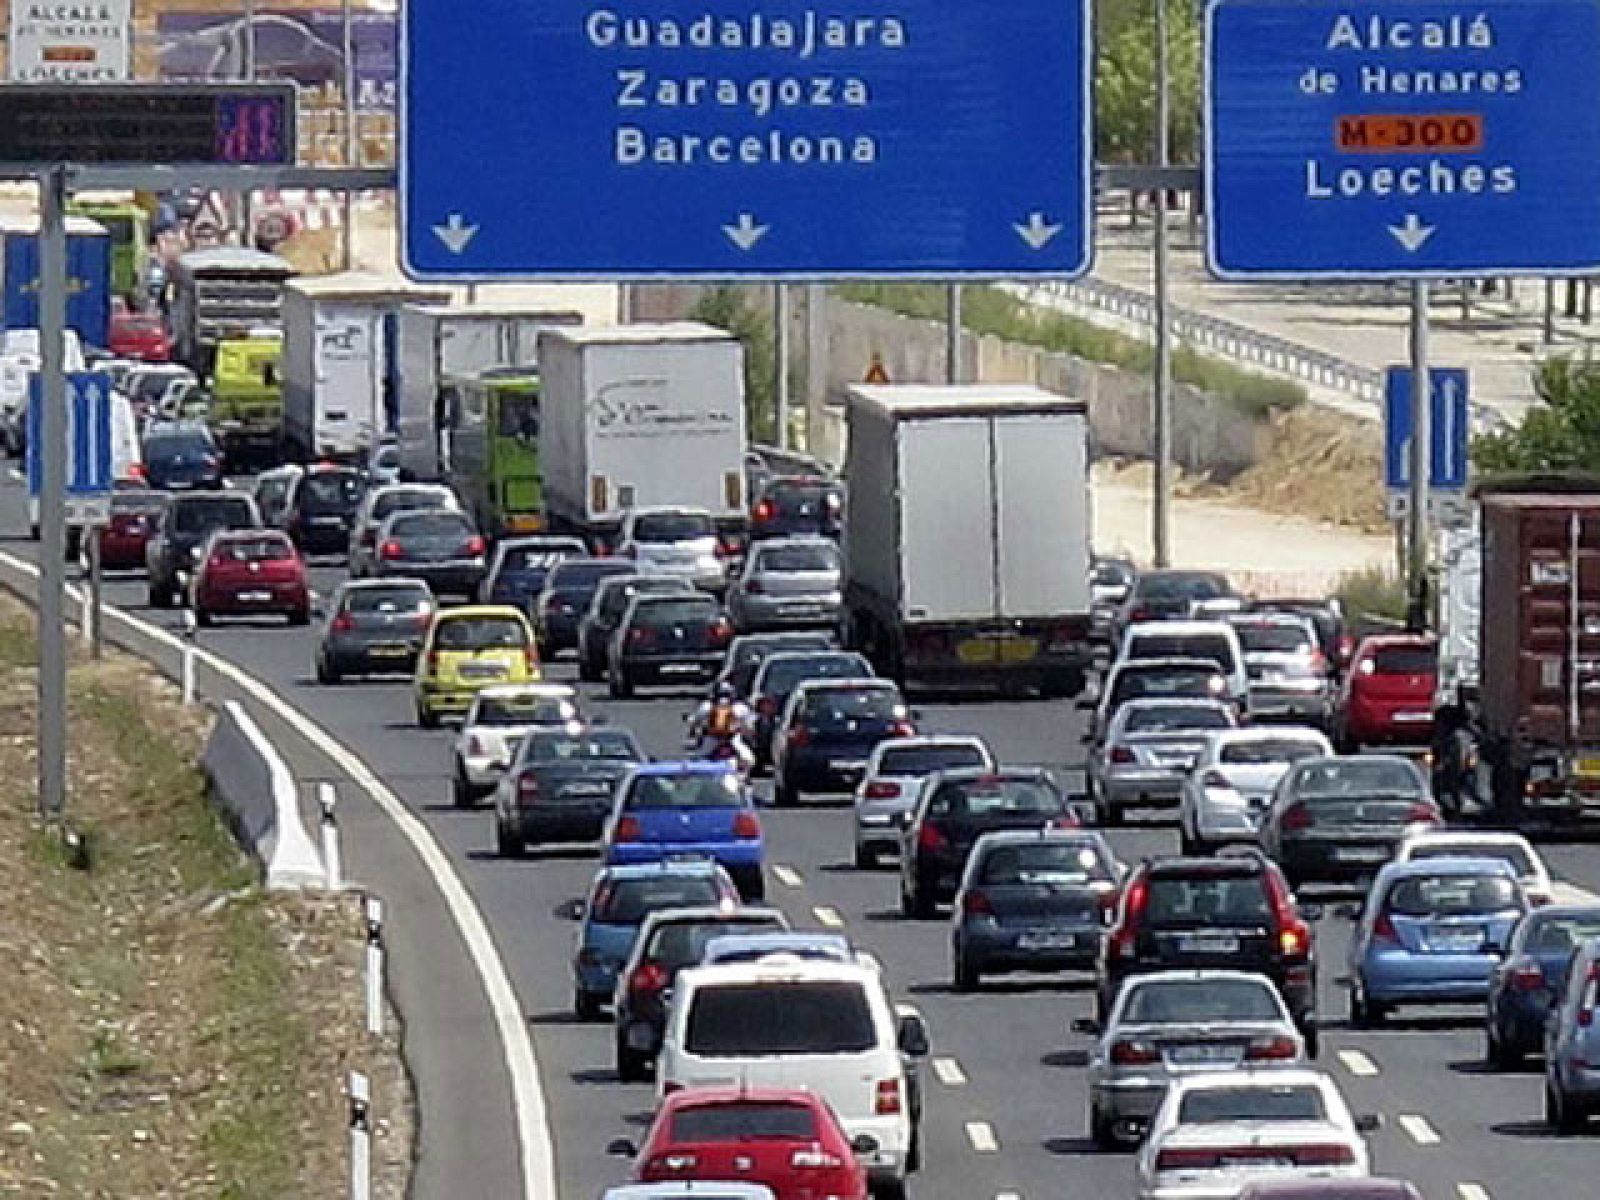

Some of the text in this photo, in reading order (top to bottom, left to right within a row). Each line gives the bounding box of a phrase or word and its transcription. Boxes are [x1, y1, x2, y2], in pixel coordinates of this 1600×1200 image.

[587, 10, 905, 58] Guadalajara
[1327, 13, 1491, 49] Alcalá
[617, 69, 867, 116] Zaragoza
[1299, 66, 1521, 94] de Henares
[616, 127, 876, 163] Barcelona
[1339, 118, 1476, 146] M-300
[1306, 159, 1516, 197] Loeches
